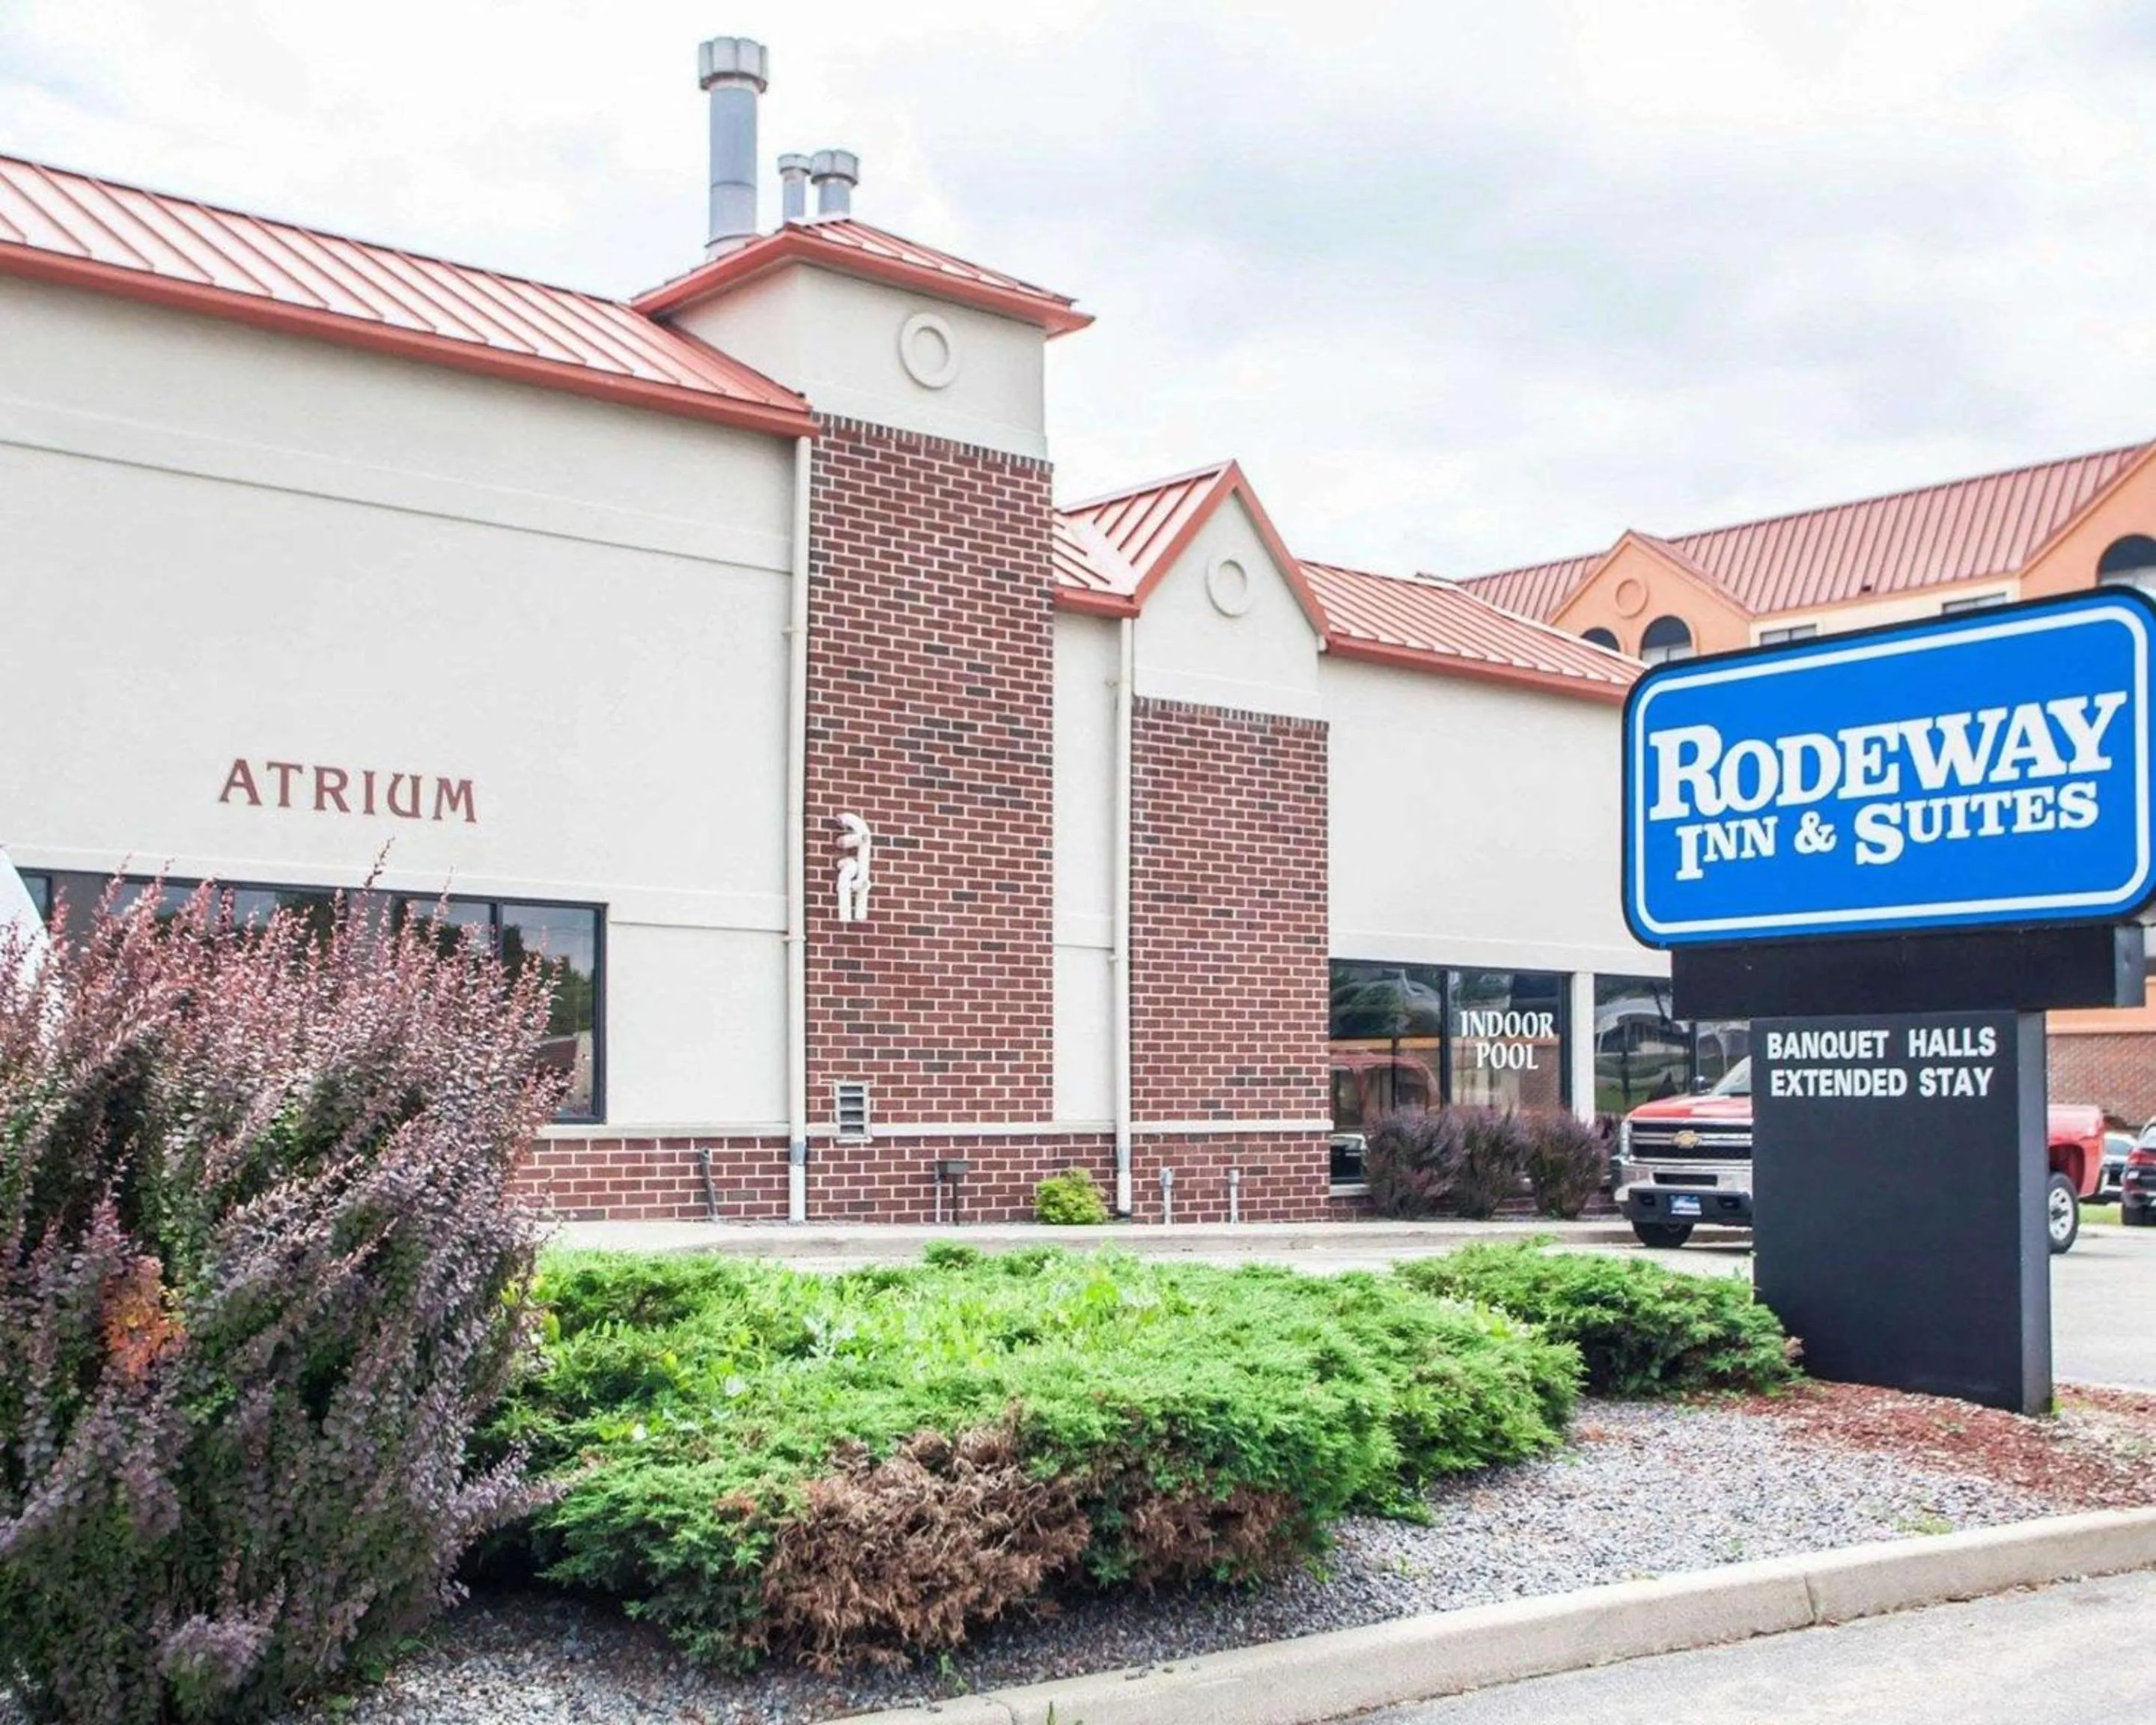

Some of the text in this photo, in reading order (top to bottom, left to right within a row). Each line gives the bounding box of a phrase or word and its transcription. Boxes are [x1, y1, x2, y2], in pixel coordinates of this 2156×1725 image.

[1649, 691, 2127, 821] RODEWAY
[217, 757, 478, 824] ATRIUM
[1675, 781, 2098, 880] INN & SUITES
[1461, 1011, 1554, 1038] INDOOR
[1476, 1042, 1538, 1070] POOL
[1767, 1026, 1996, 1059] BANQUET HALLS
[1770, 1068, 1994, 1097] EXTENDED STAY
